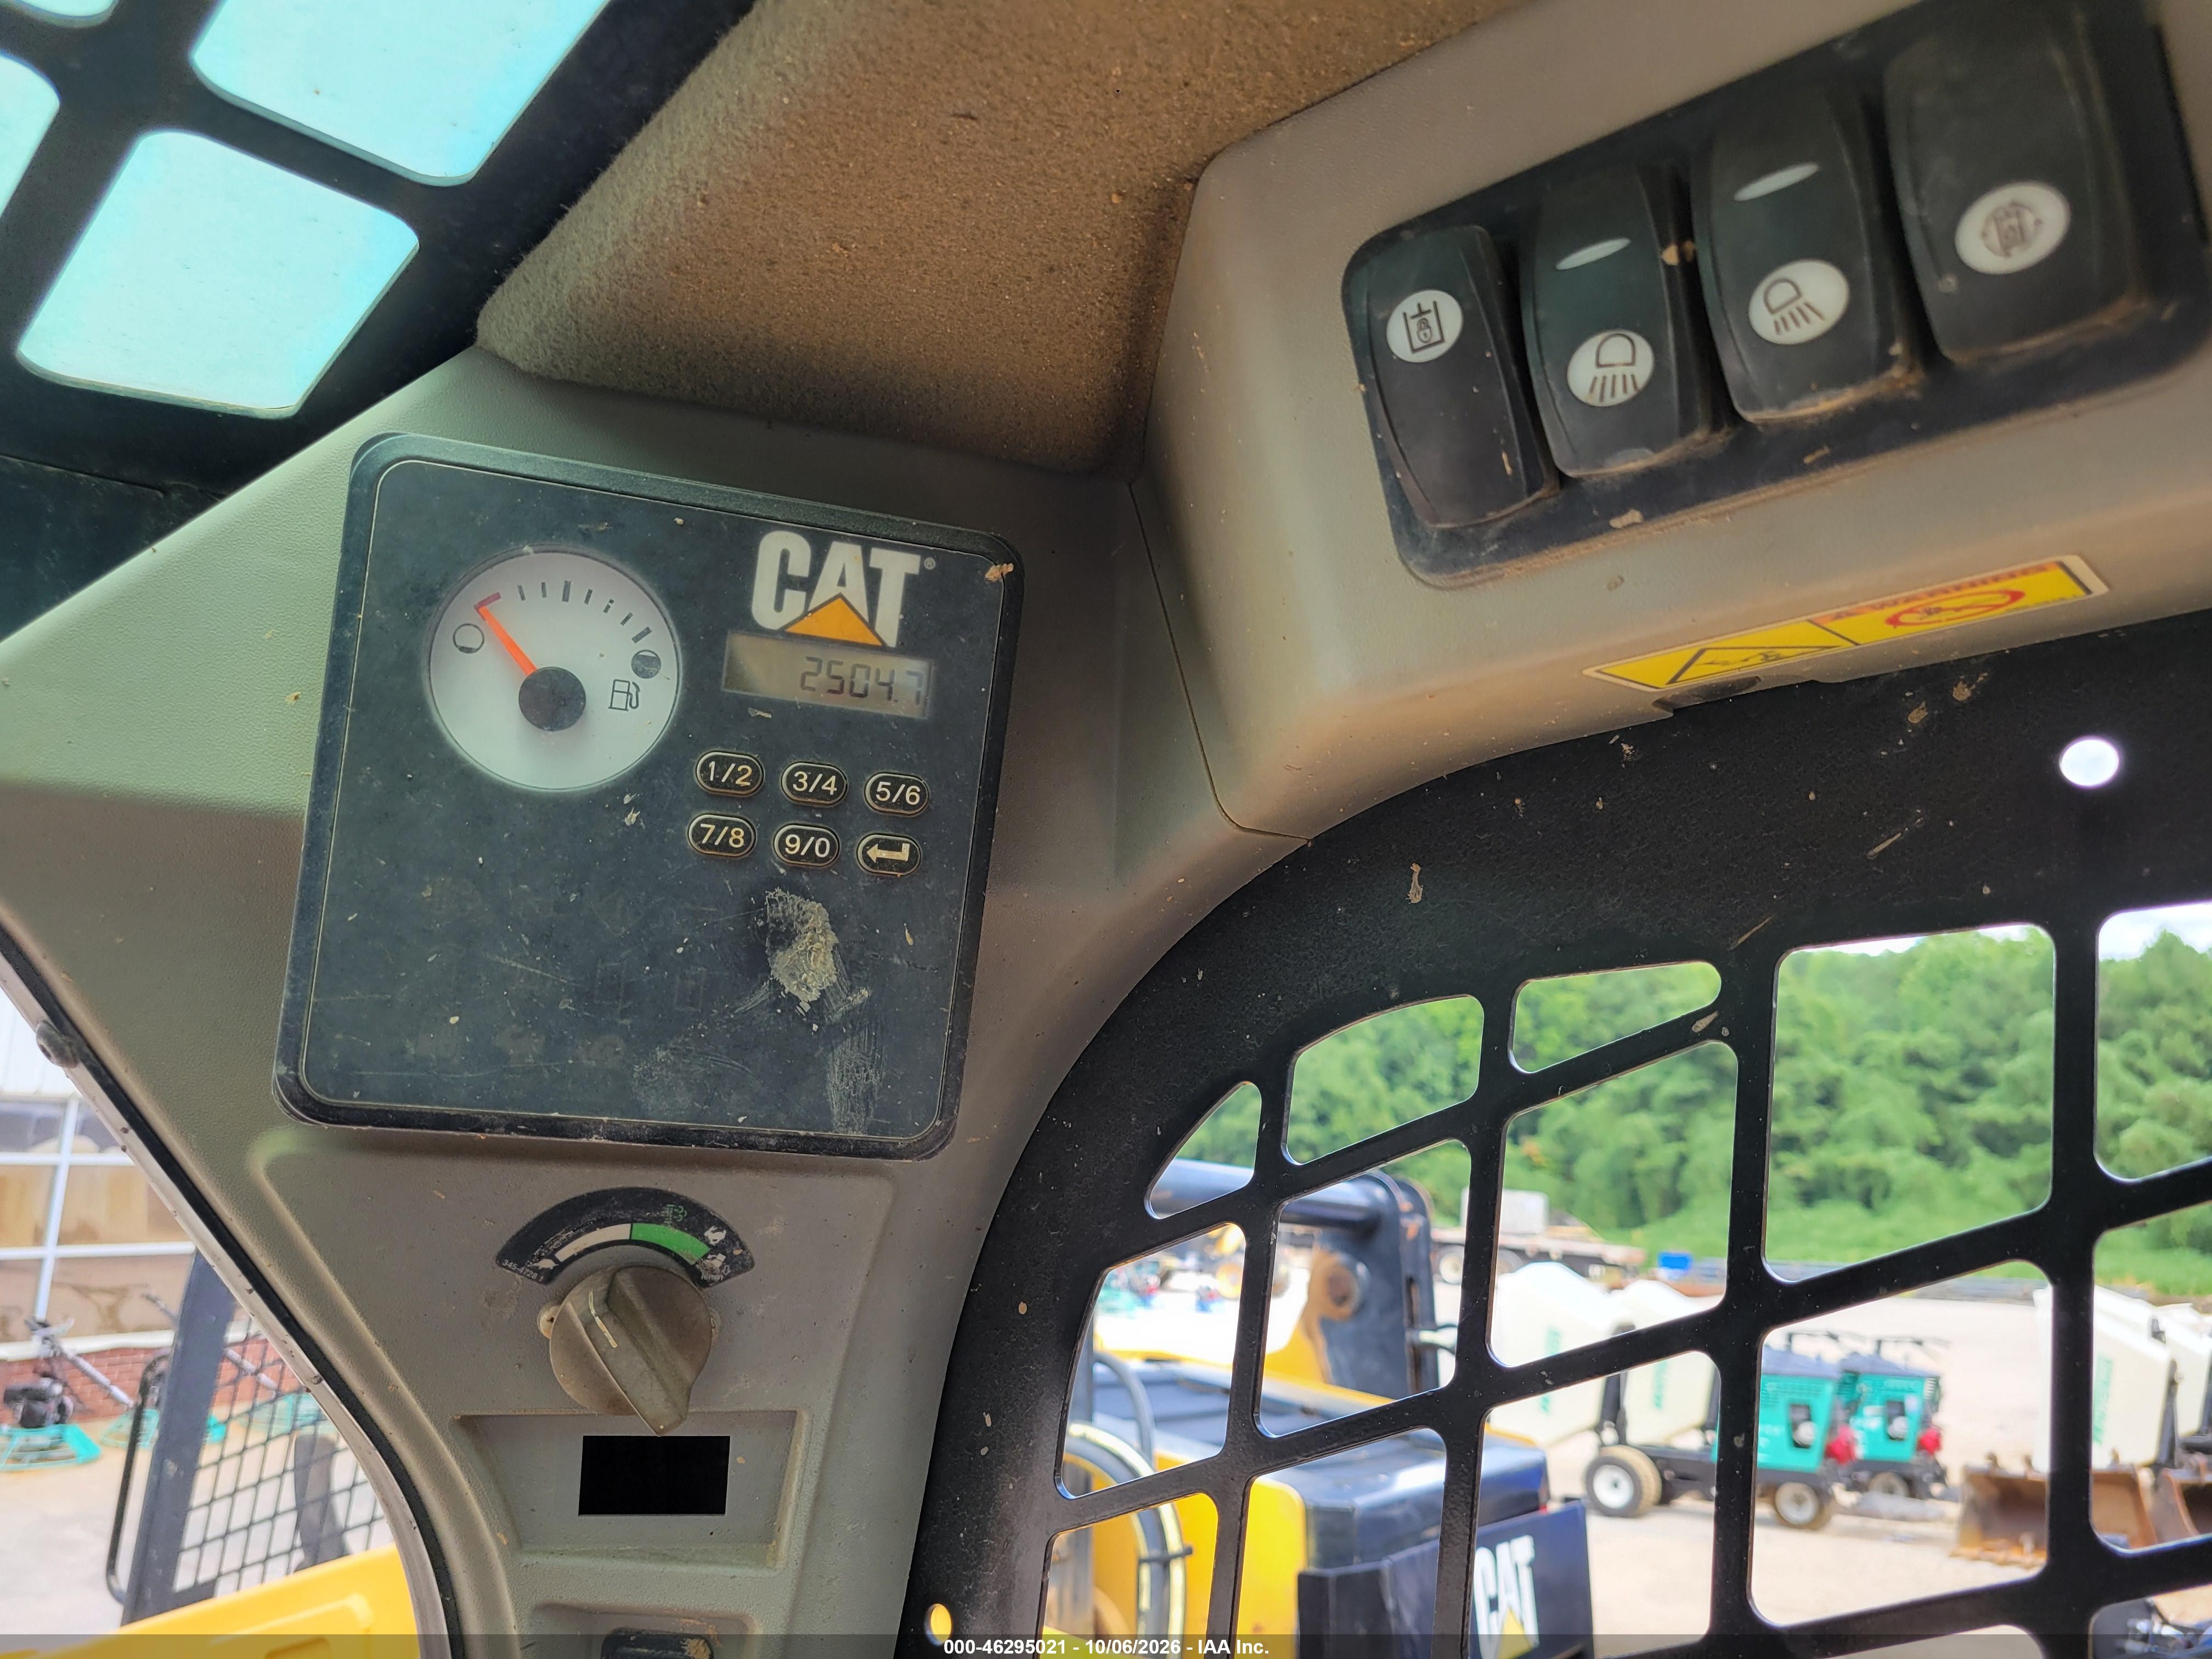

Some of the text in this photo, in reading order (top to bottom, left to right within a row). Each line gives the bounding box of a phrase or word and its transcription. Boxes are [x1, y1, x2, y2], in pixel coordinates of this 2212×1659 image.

[752, 530, 921, 648] CAT
[800, 656, 924, 706] 2504.7
[708, 760, 753, 787] 1/2
[792, 770, 838, 796] 3/4
[875, 781, 921, 806] 5/6
[699, 823, 745, 849] 7/8
[784, 834, 831, 859] 9/0
[1472, 1534, 1539, 1659] CAT
